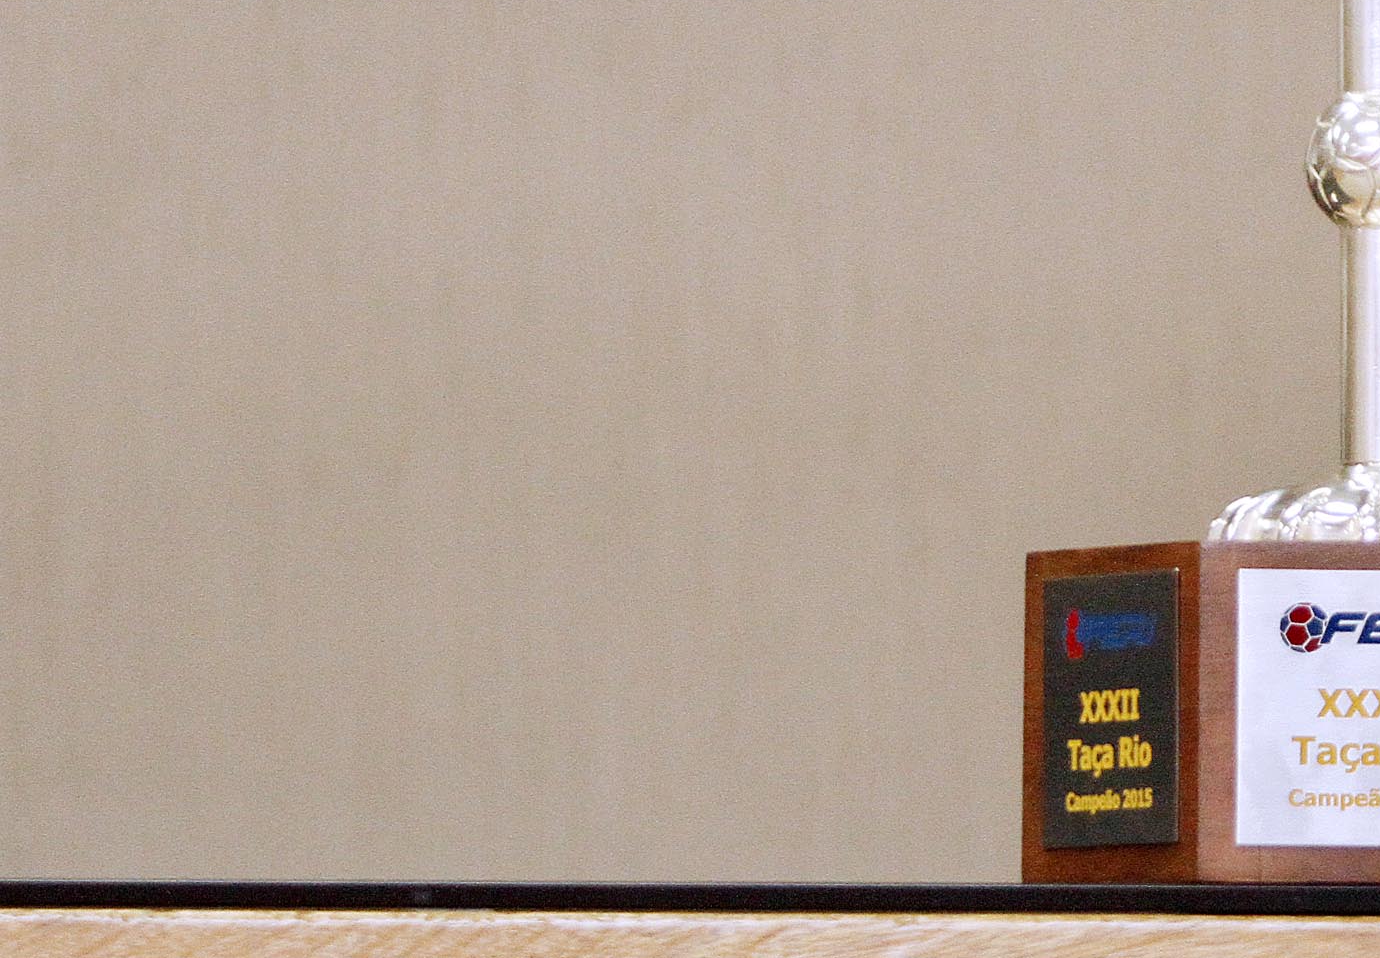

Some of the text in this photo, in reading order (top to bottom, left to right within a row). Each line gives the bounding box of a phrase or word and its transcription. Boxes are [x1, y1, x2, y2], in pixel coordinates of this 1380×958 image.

[1079, 688, 1140, 723] XXXII
[1067, 734, 1152, 777] Taça Rio
[1065, 788, 1153, 814] Campeão 2015
